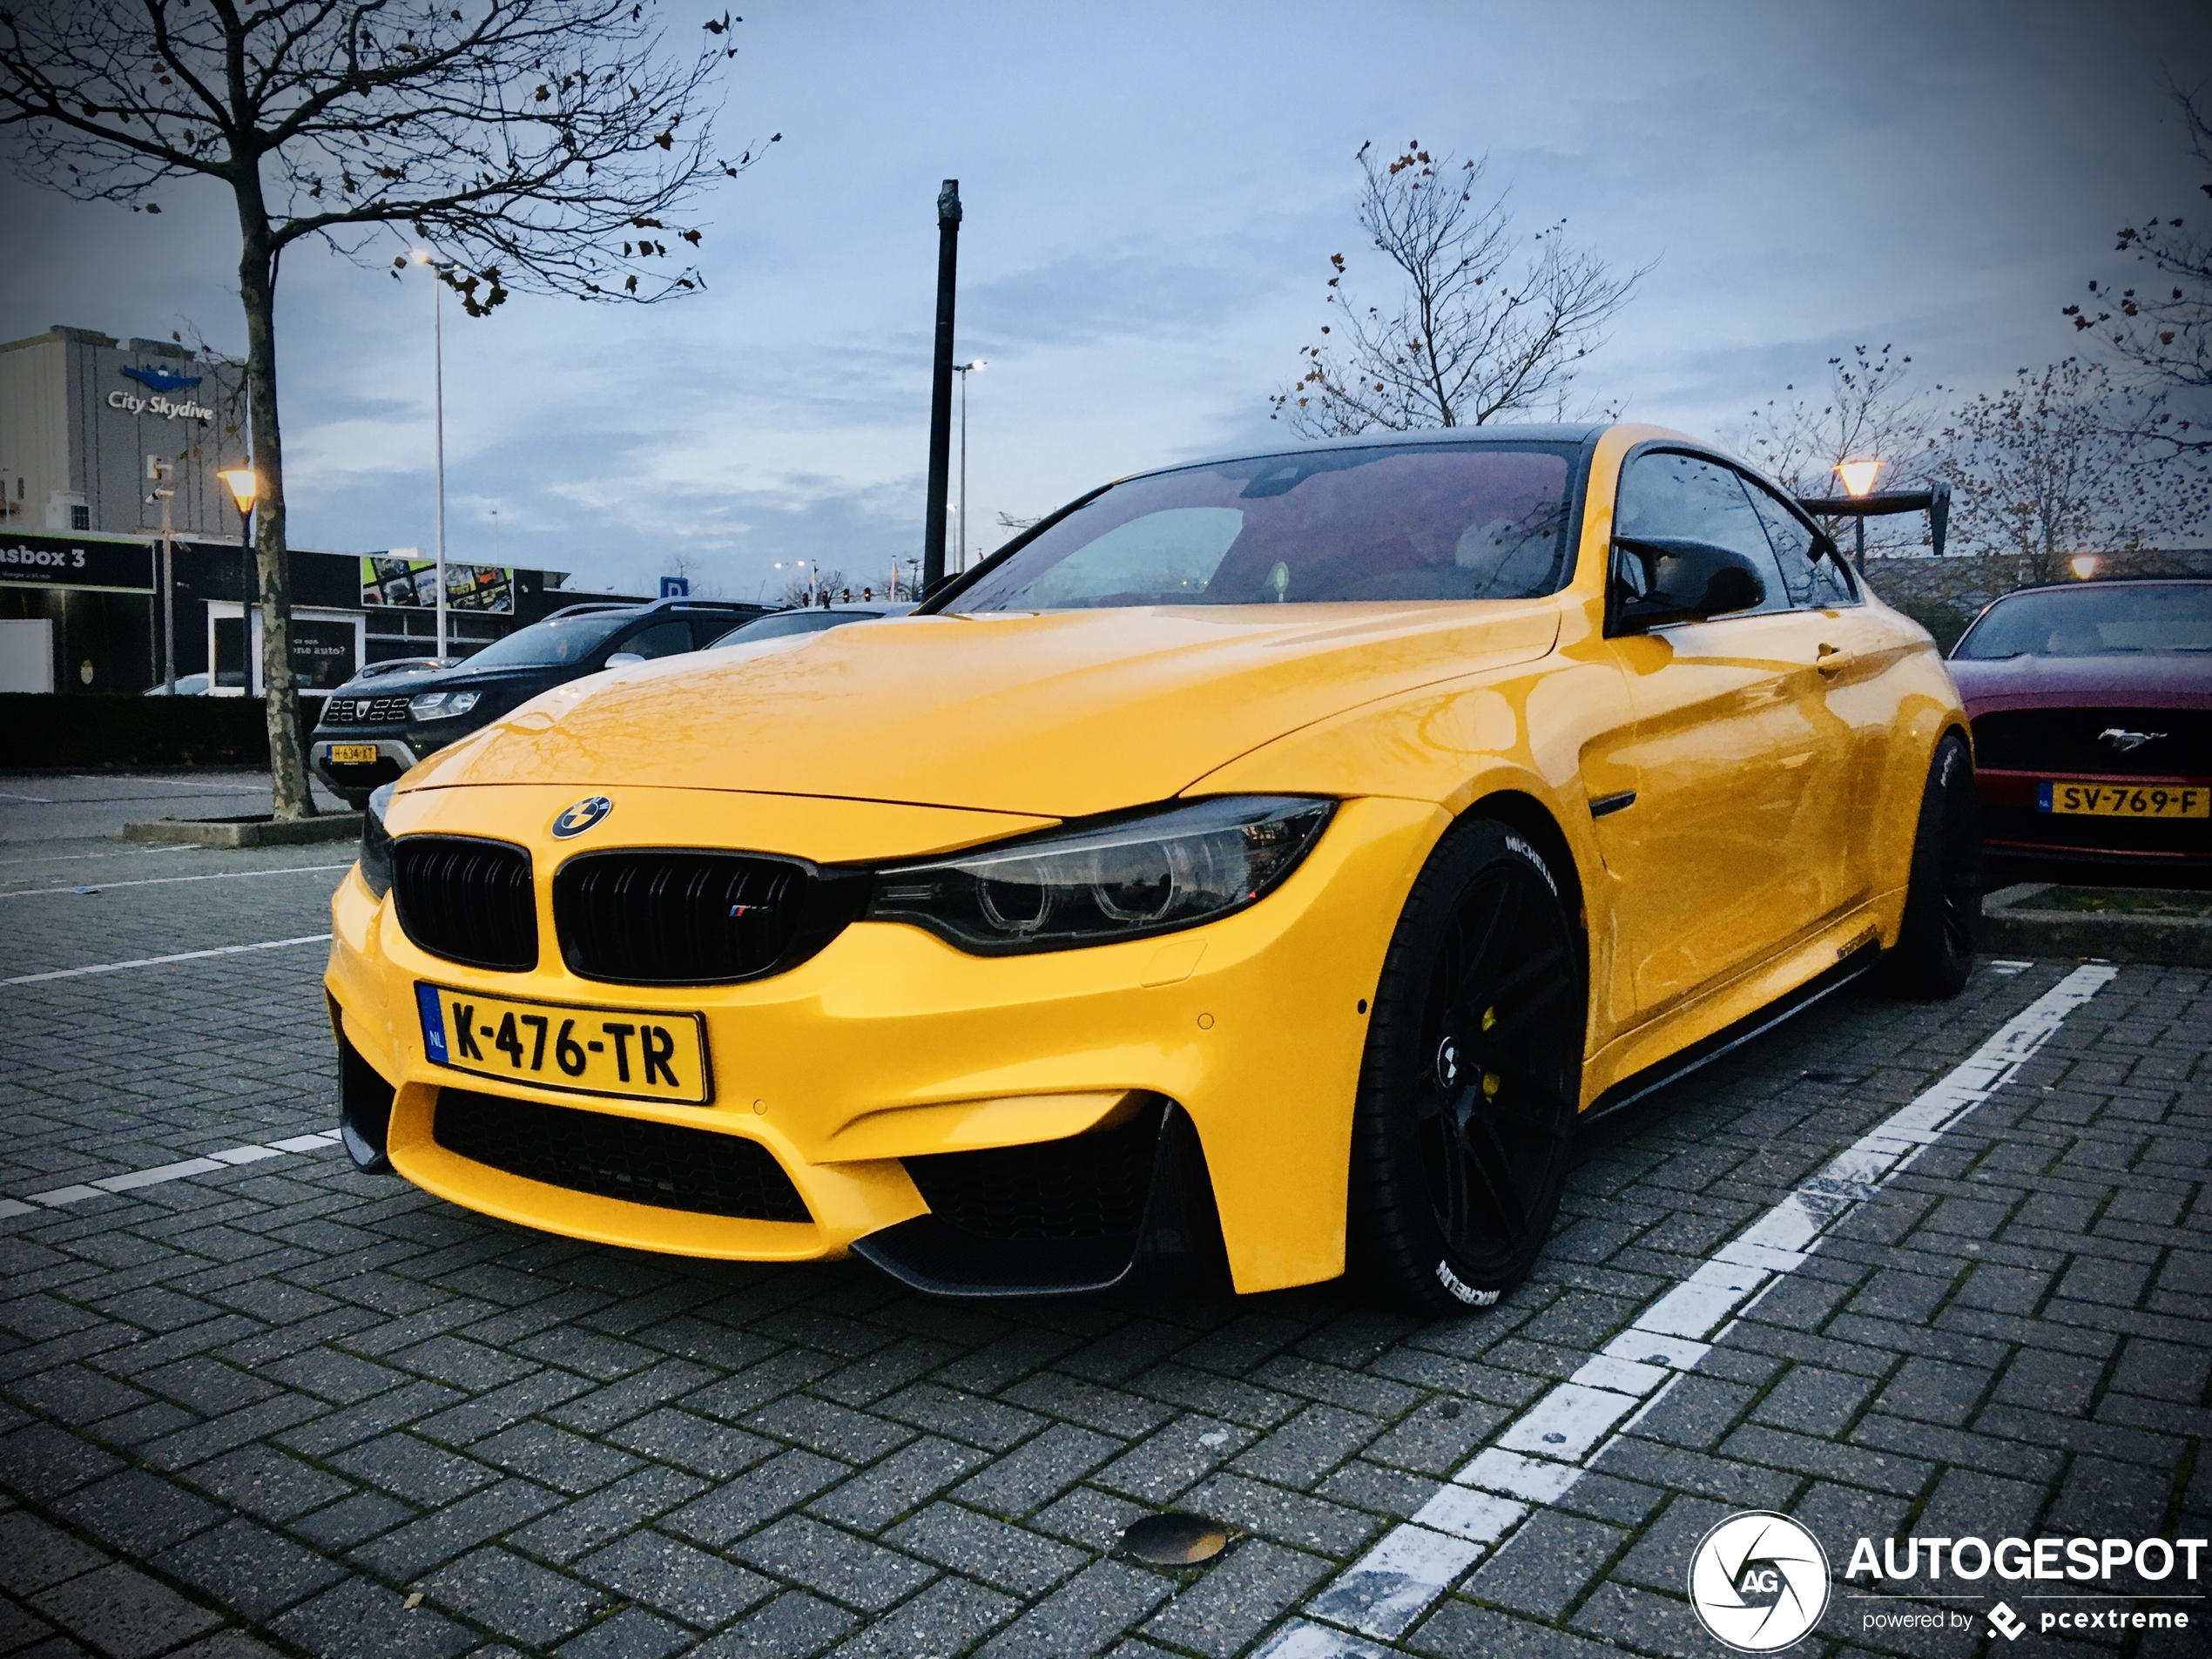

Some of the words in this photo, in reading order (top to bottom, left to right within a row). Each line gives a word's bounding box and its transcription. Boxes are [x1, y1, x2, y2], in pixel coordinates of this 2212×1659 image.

[108, 390, 146, 415] City
[149, 396, 213, 420] Skydive
[71, 549, 85, 568] 3
[314, 646, 346, 655] auto?
[334, 747, 373, 759] H-634-XT
[2039, 799, 2050, 808] NL
[2064, 787, 2197, 813] SV-769-F
[1505, 835, 1557, 897] MICHELIN
[429, 1030, 445, 1049] NL
[452, 1001, 679, 1088] K-476-TR
[1435, 1259, 1501, 1306] MICHELIN
